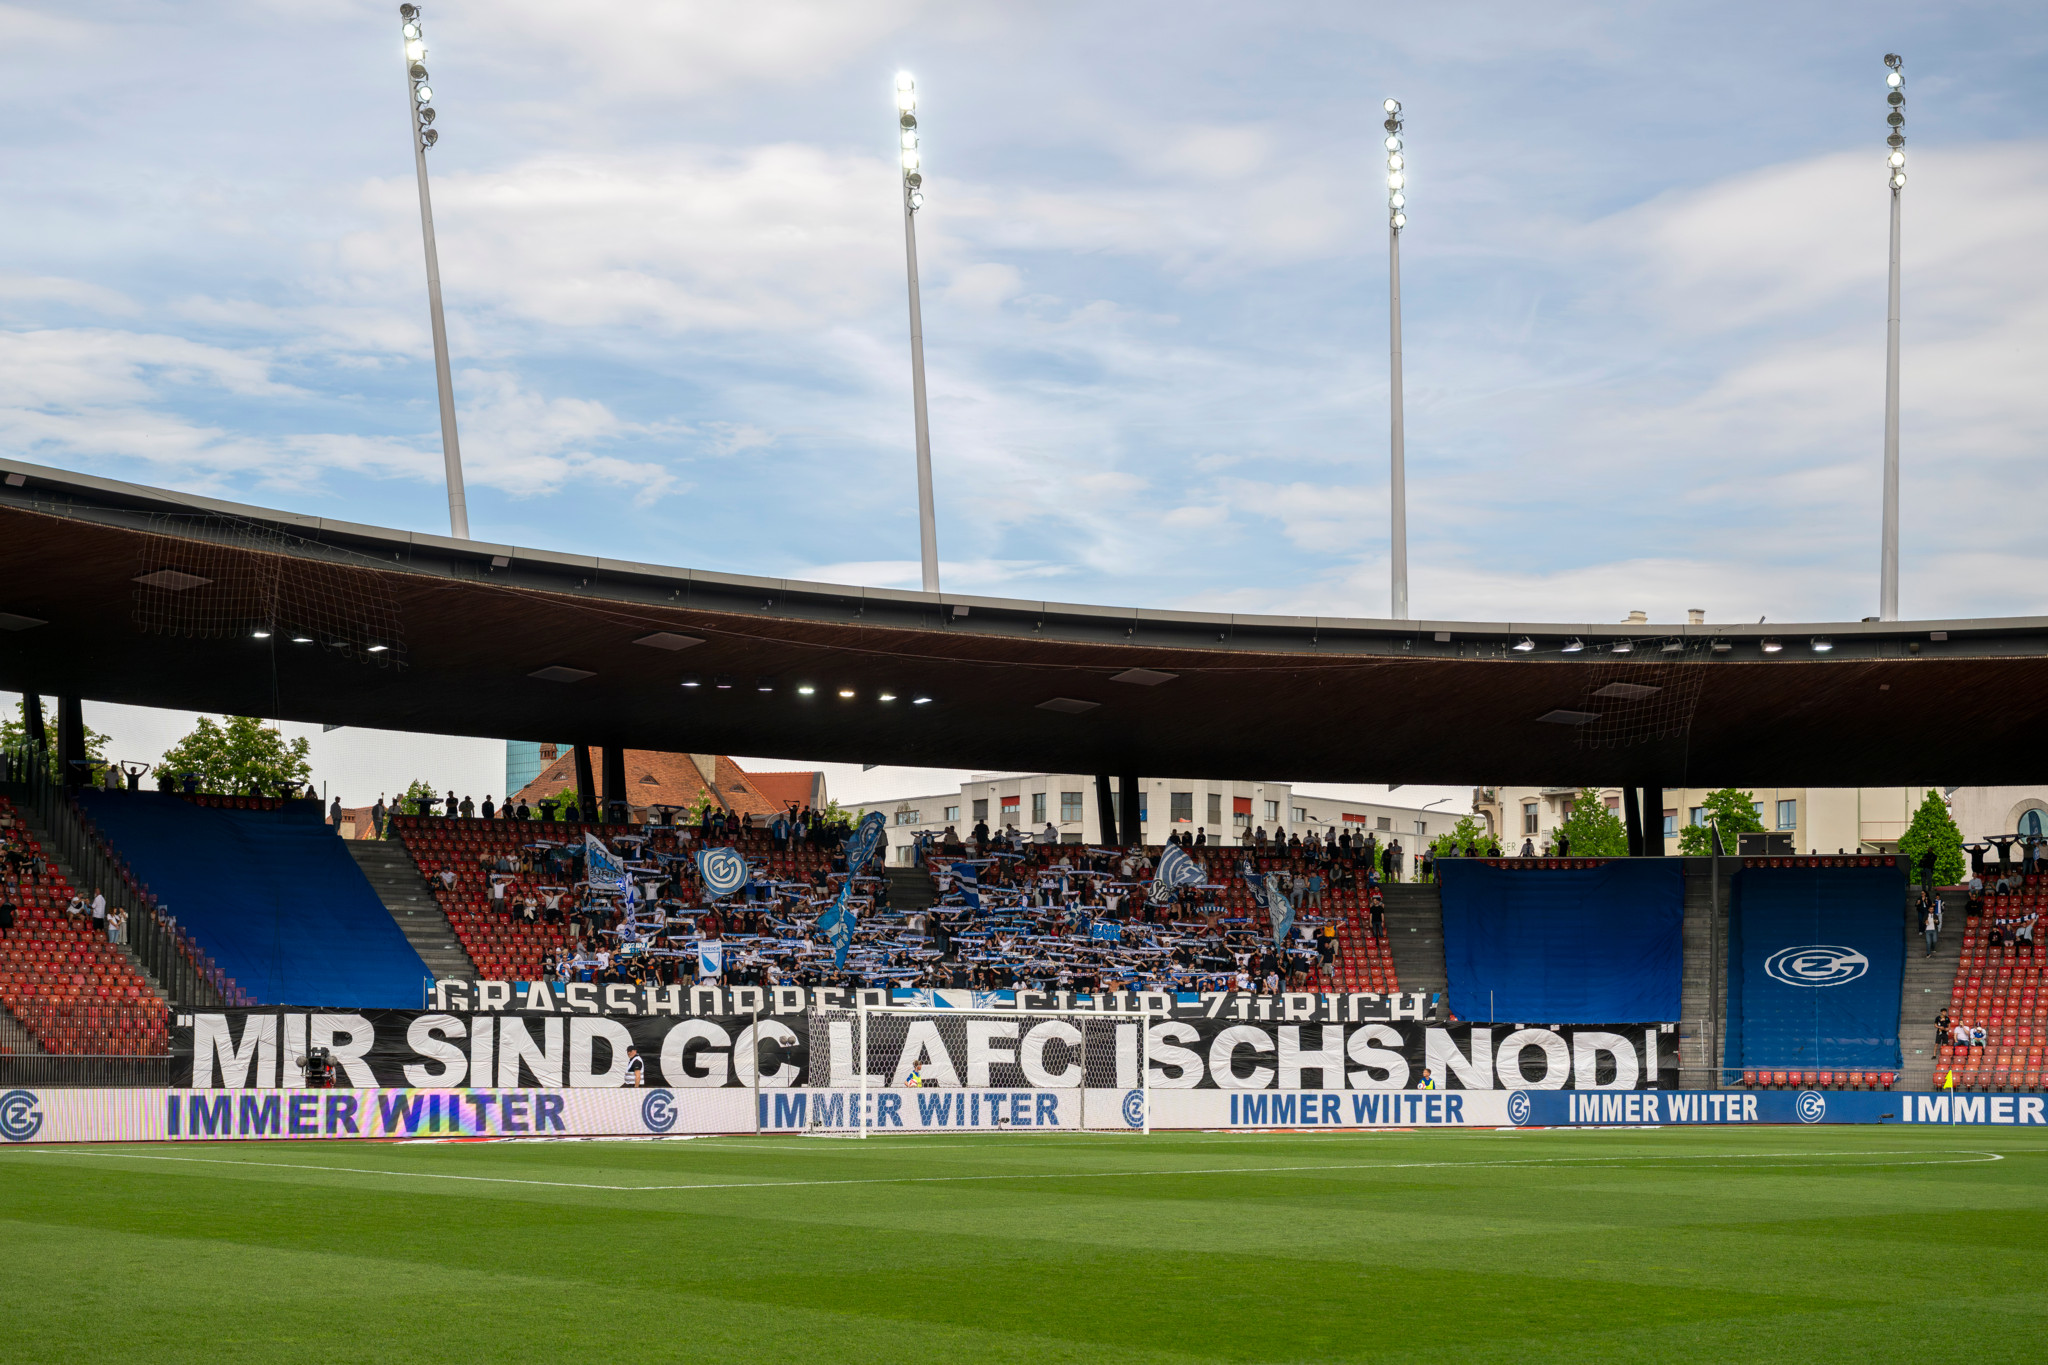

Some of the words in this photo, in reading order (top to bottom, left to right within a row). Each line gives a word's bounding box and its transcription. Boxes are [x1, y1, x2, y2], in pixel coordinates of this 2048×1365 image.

[403, 1014, 631, 1088] SIND
[660, 1018, 801, 1088] GC
[1116, 1021, 1410, 1090] ISCHS
[167, 1094, 359, 1136] IMMER
[376, 1093, 566, 1133] WIITER
[760, 1093, 903, 1129] IMMER
[917, 1092, 1060, 1127] WIITER
[1230, 1094, 1343, 1125] IMMER
[1352, 1093, 1464, 1124] WIITER
[1568, 1094, 1660, 1123] IMMER
[1667, 1094, 1758, 1122] WIITER
[1902, 1095, 2047, 1124] IMMER
